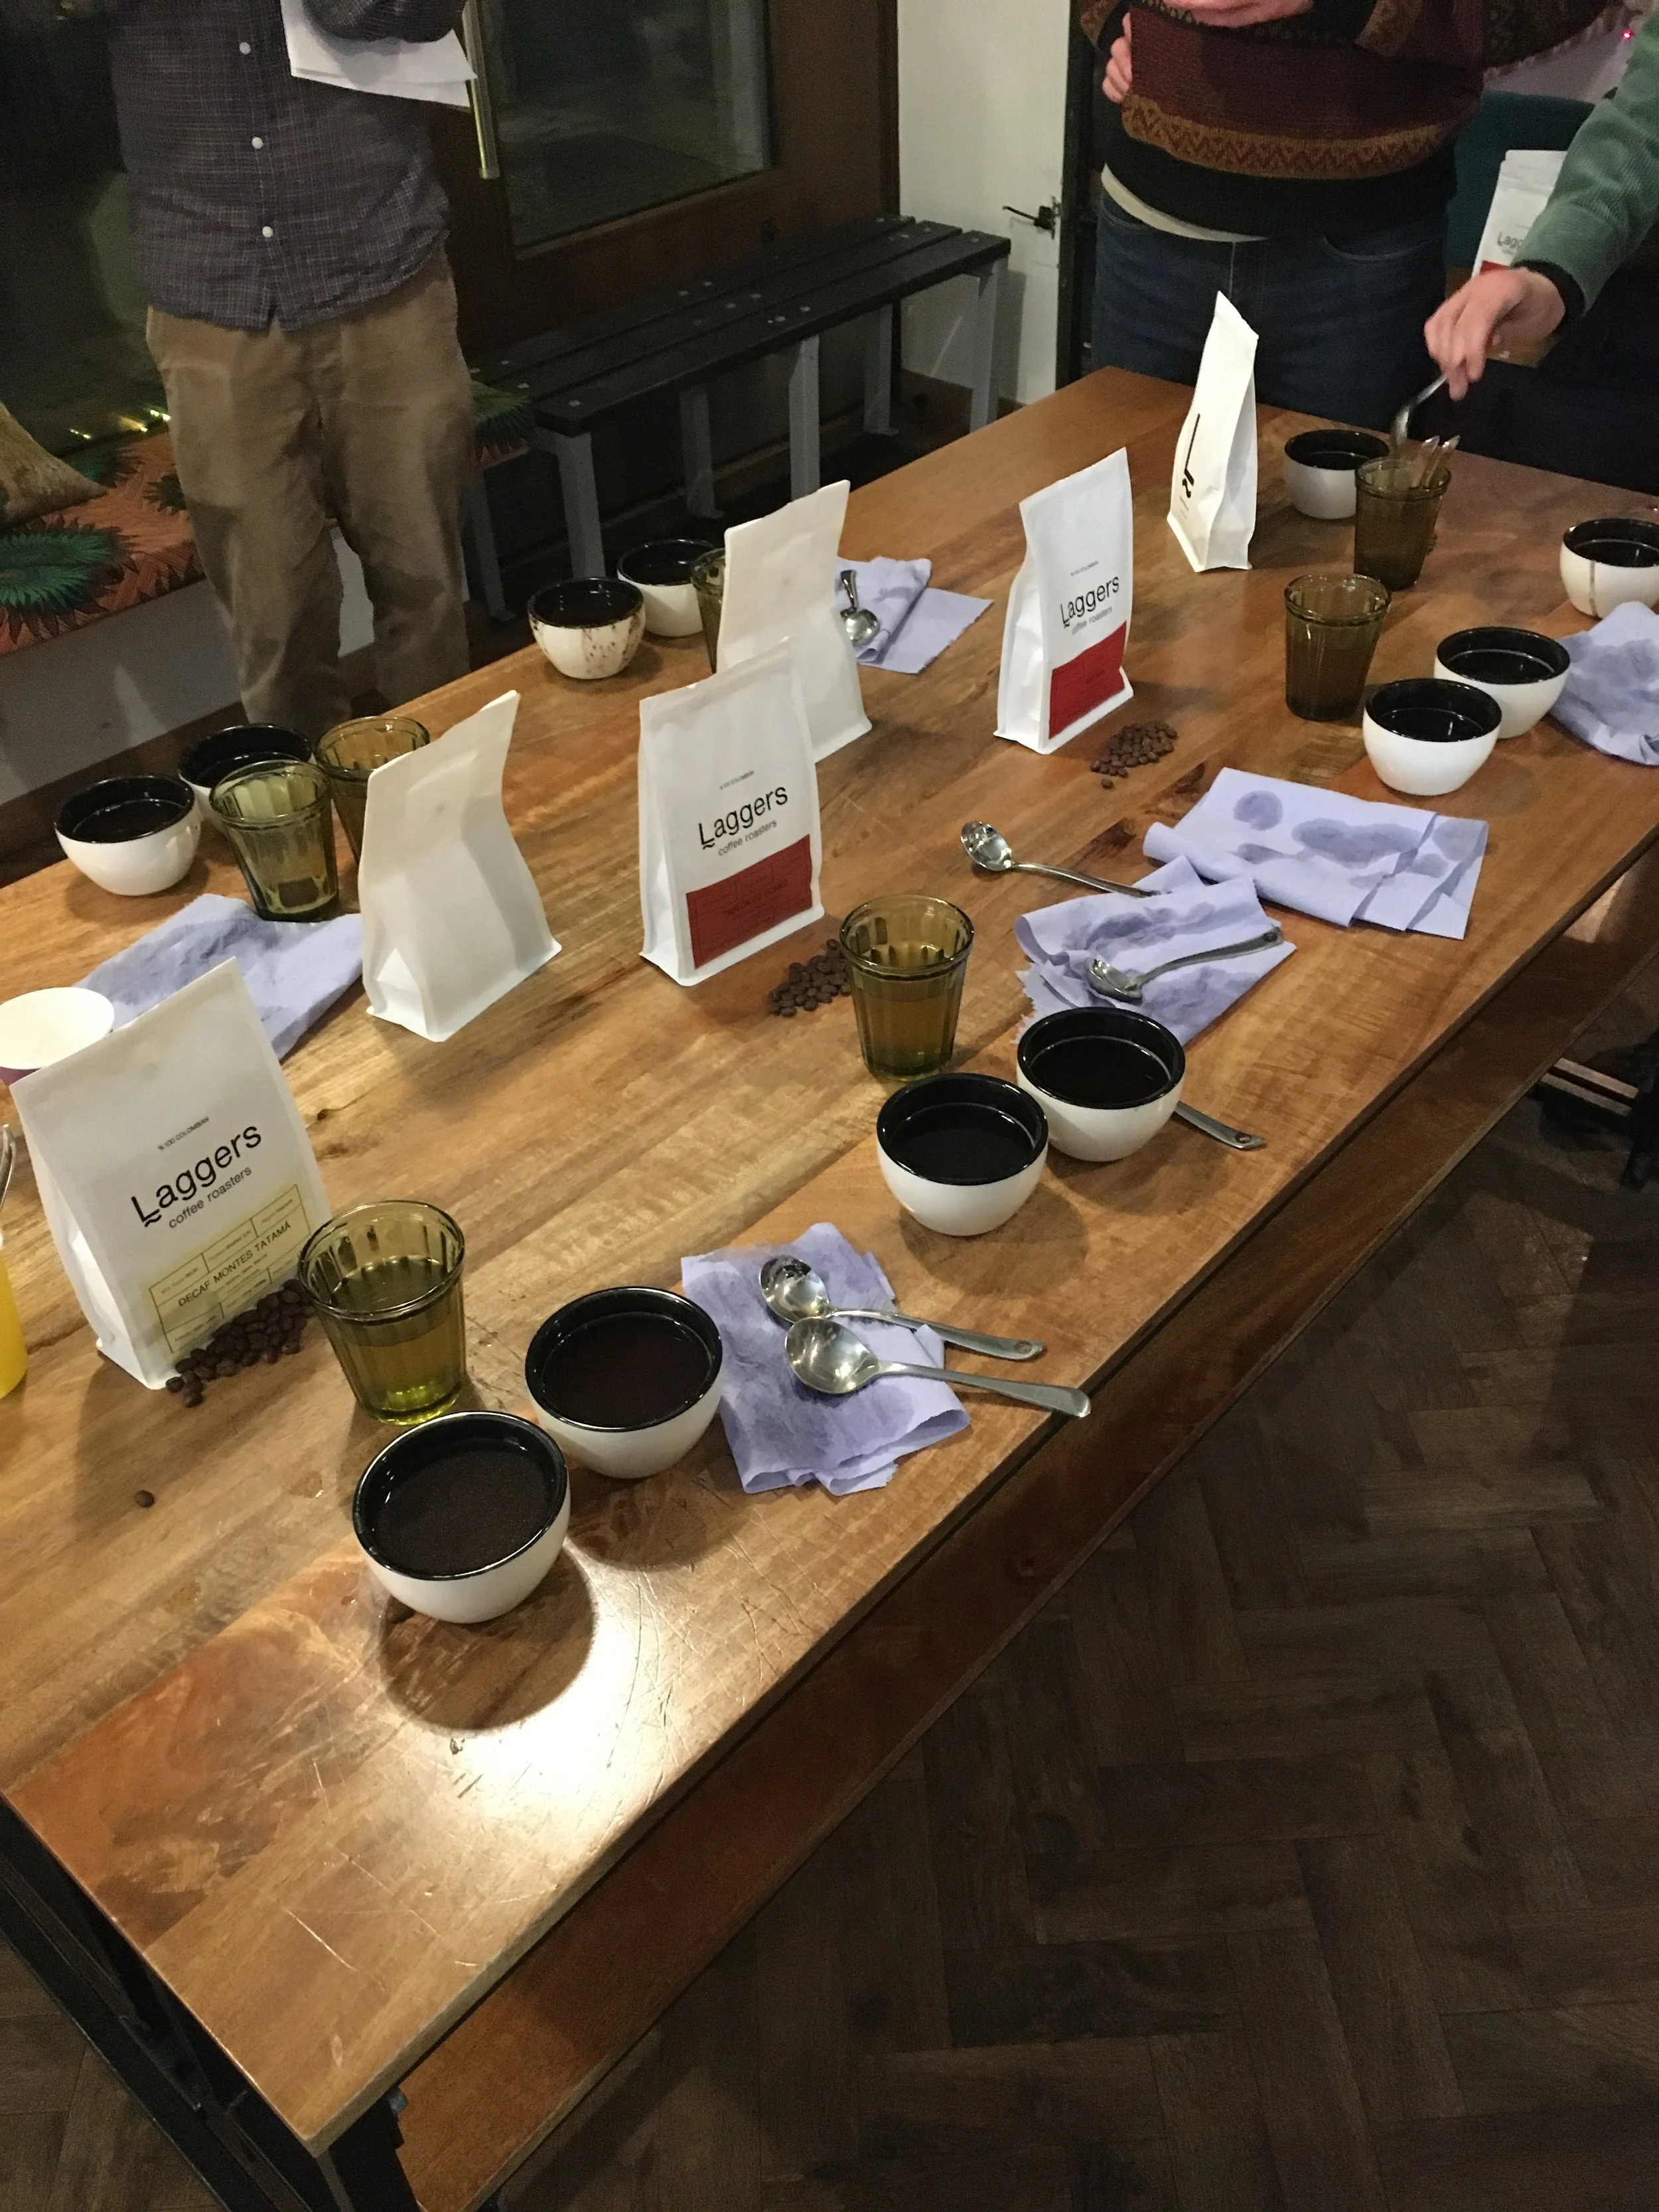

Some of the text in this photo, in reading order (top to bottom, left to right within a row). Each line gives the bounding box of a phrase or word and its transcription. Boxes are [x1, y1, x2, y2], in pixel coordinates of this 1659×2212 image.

[1060, 576, 1119, 628] Laggers
[699, 786, 788, 849] Laggers
[718, 820, 778, 856] coffee roasters
[131, 1126, 261, 1227] Laggers
[169, 1167, 252, 1228] coffee roasters
[178, 1280, 211, 1307] DECAF
[212, 1250, 253, 1284] MONTES
[254, 1220, 291, 1252] TATAMÁ
